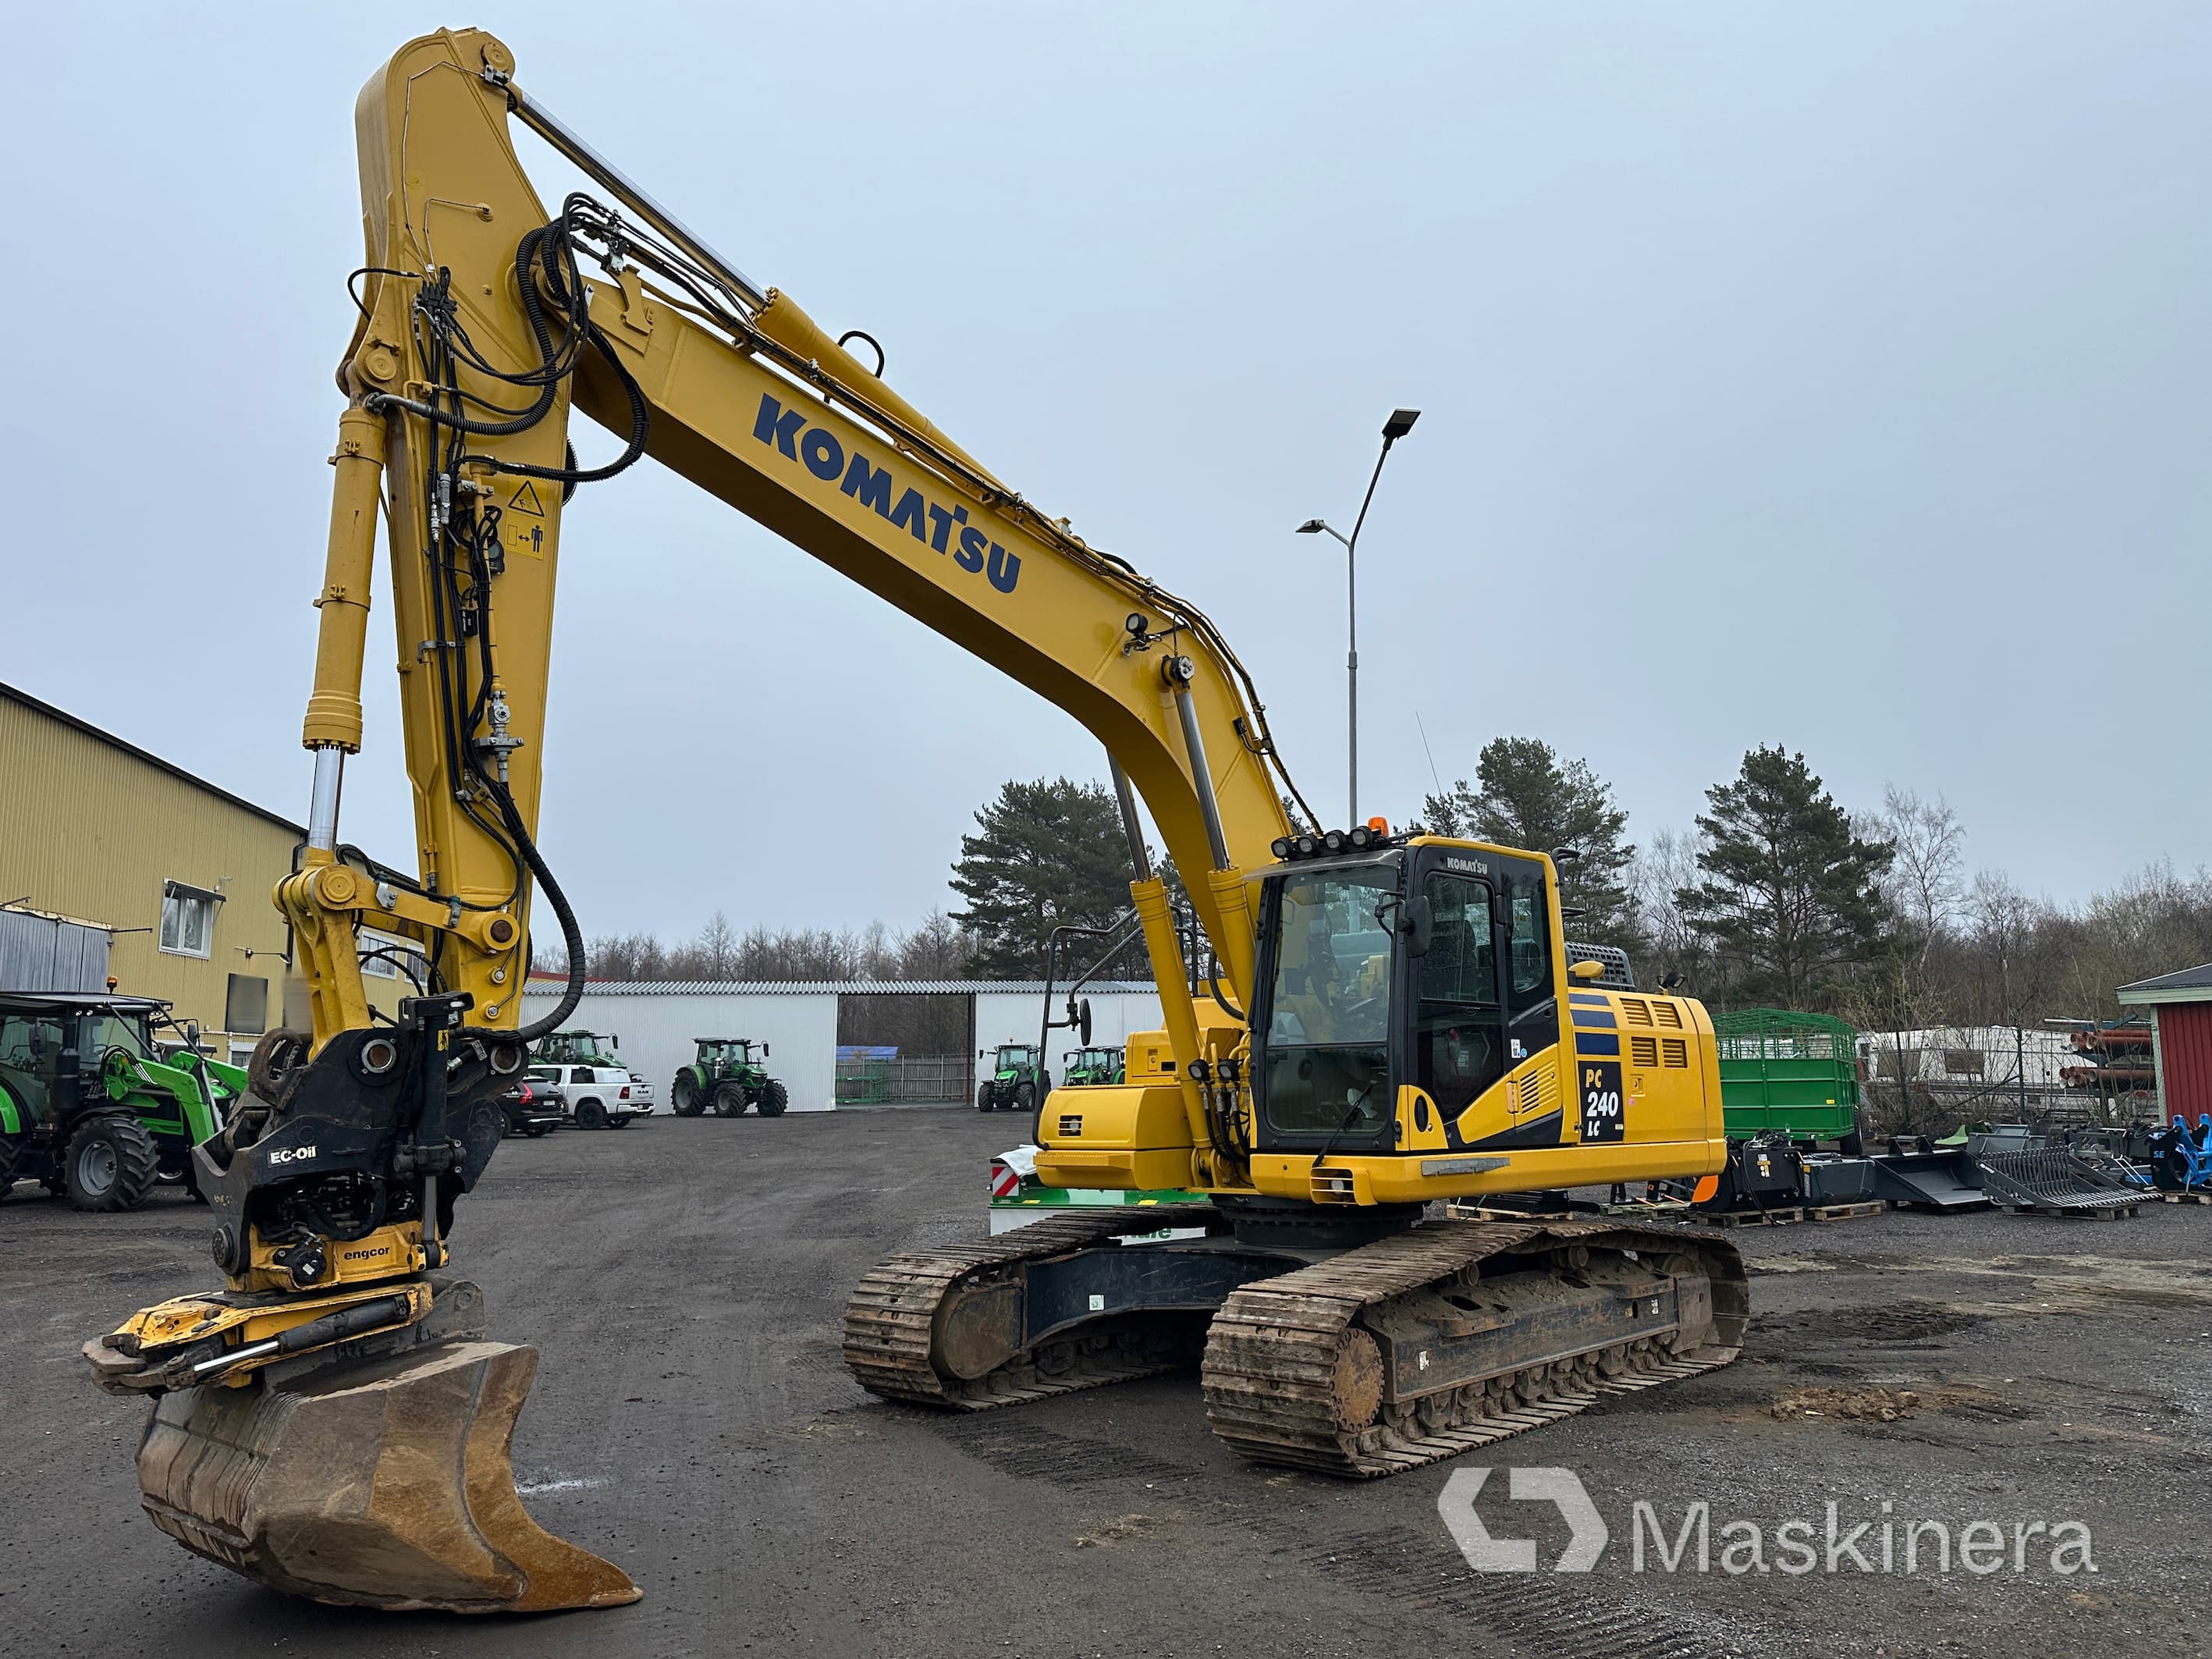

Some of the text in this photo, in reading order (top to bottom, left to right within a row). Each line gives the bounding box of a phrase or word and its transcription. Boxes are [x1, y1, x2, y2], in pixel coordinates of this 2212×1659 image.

[753, 393, 1021, 594] KOMATSU
[1447, 857, 1488, 875] KOMATSU
[1585, 1069, 1602, 1088] PC
[1586, 1092, 1619, 1117] 240
[1587, 1121, 1600, 1136] LC
[270, 1146, 318, 1164] EC-Oil
[344, 1247, 390, 1259] engcor
